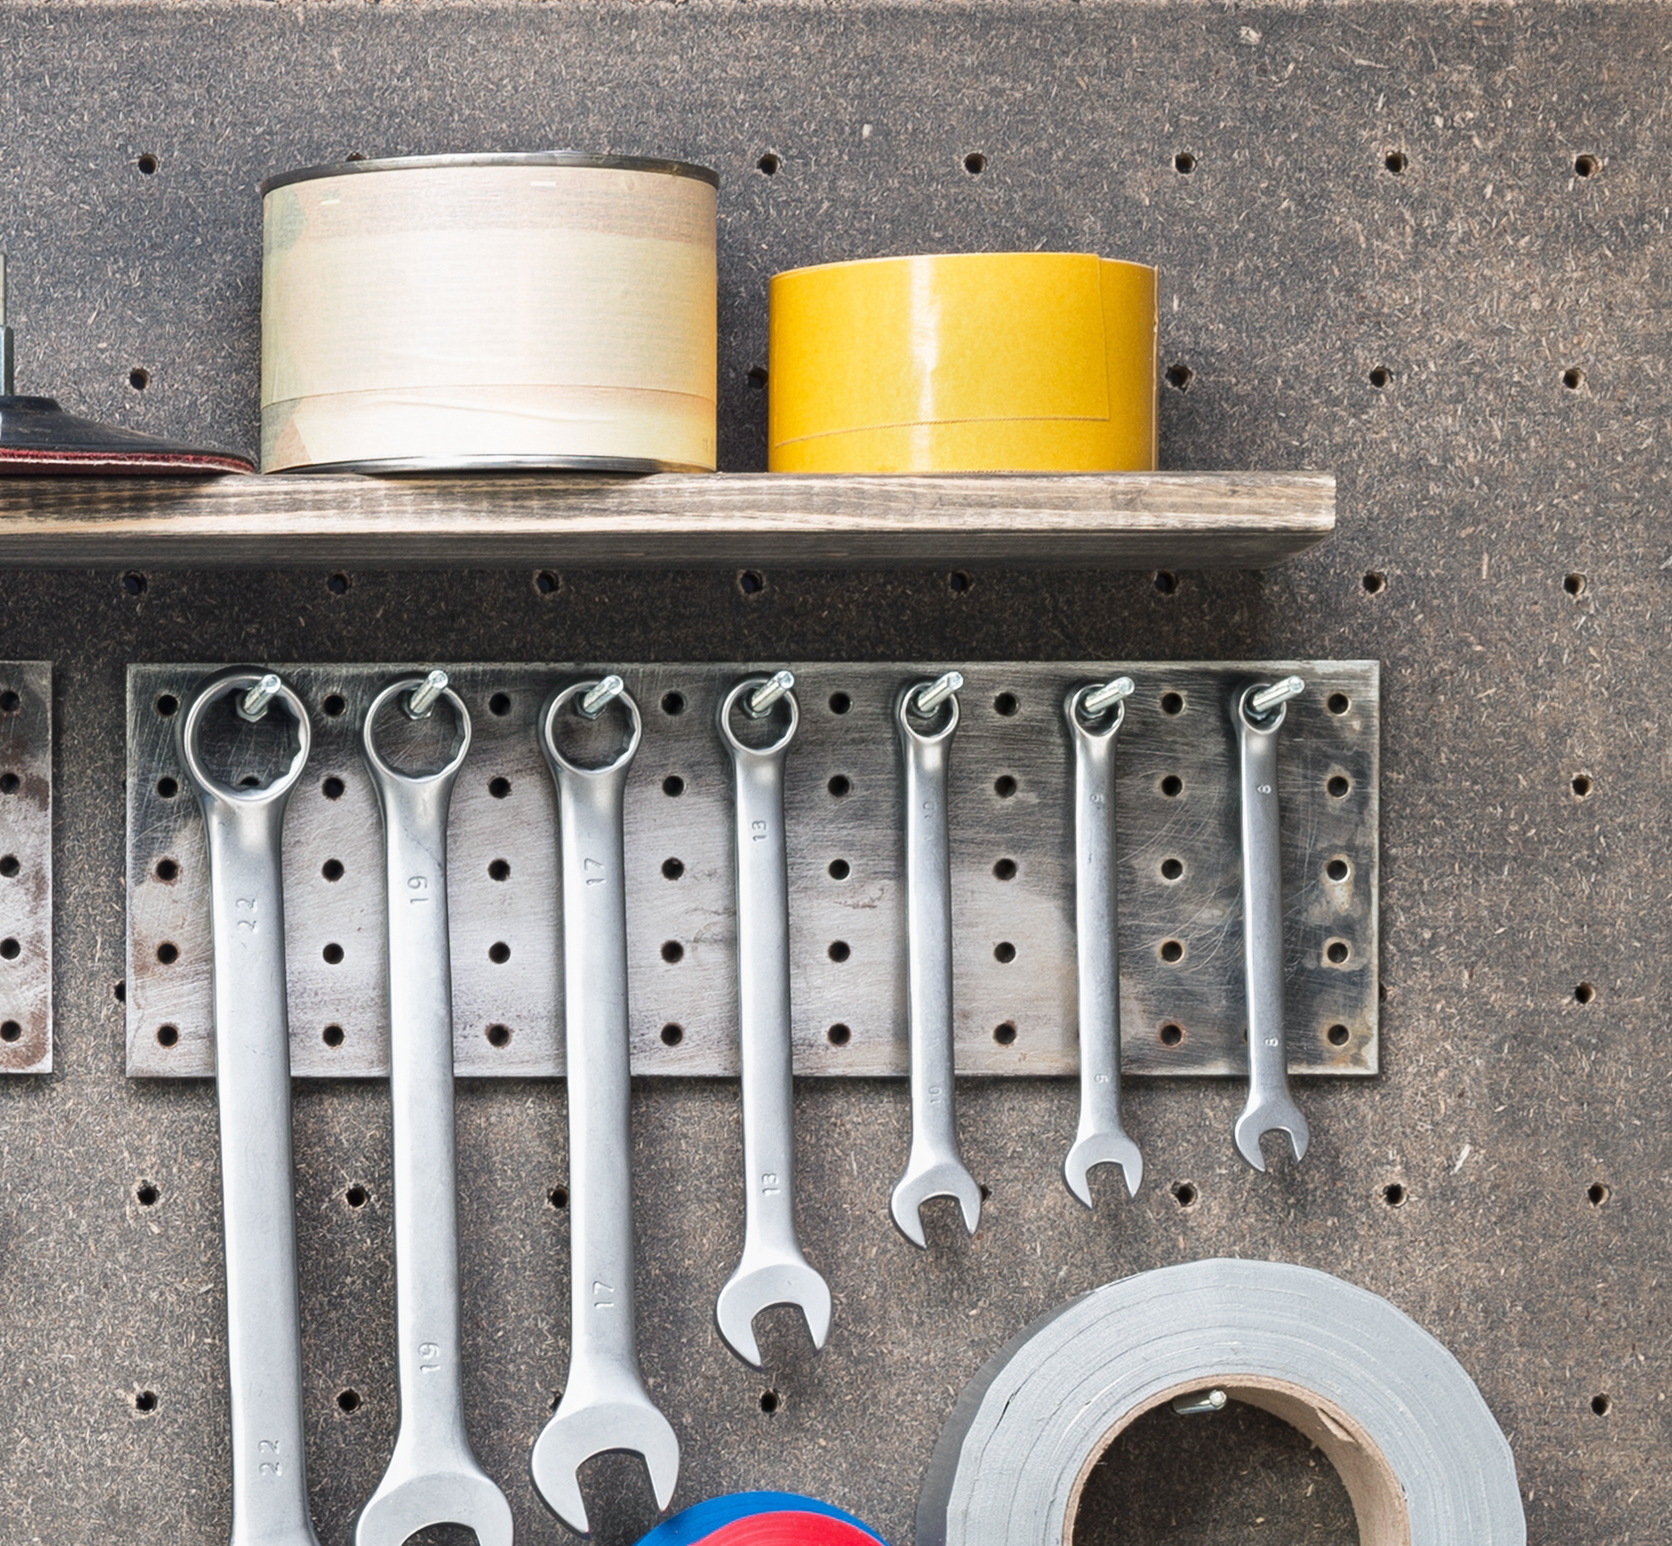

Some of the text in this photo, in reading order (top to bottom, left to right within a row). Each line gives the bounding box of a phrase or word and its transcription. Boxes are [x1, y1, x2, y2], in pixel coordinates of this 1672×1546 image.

[752, 821, 768, 846] 13
[584, 857, 607, 886] 17
[406, 876, 429, 908] 19
[236, 897, 257, 933] 22
[762, 1172, 781, 1197] 13
[592, 1281, 615, 1310] 17
[418, 1341, 440, 1372] 19
[257, 1440, 283, 1476] 22
